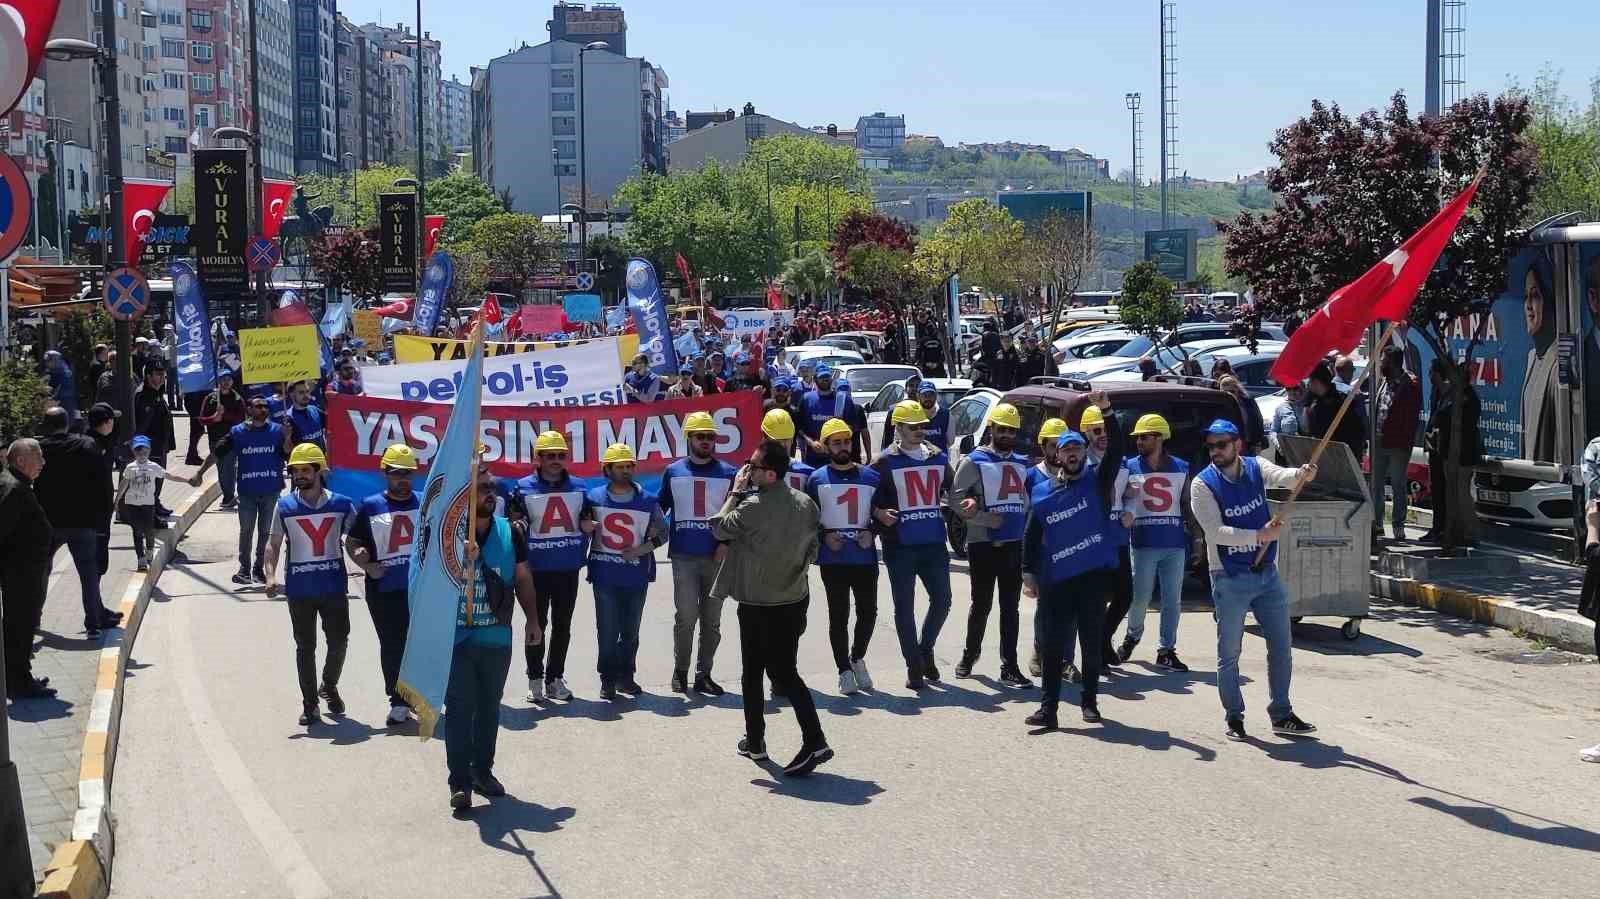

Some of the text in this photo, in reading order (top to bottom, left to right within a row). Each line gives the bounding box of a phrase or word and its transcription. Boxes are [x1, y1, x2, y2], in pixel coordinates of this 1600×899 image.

[215, 178, 229, 254] VURAL
[401, 361, 568, 401] petol-iş
[347, 407, 742, 465] YAŞSIN 1 MAYS
[904, 469, 940, 507] M
[997, 464, 1024, 500] A
[1143, 477, 1172, 512] S
[538, 496, 576, 534] A
[837, 488, 858, 525] 1
[295, 516, 337, 556] Y
[602, 513, 634, 550] S
